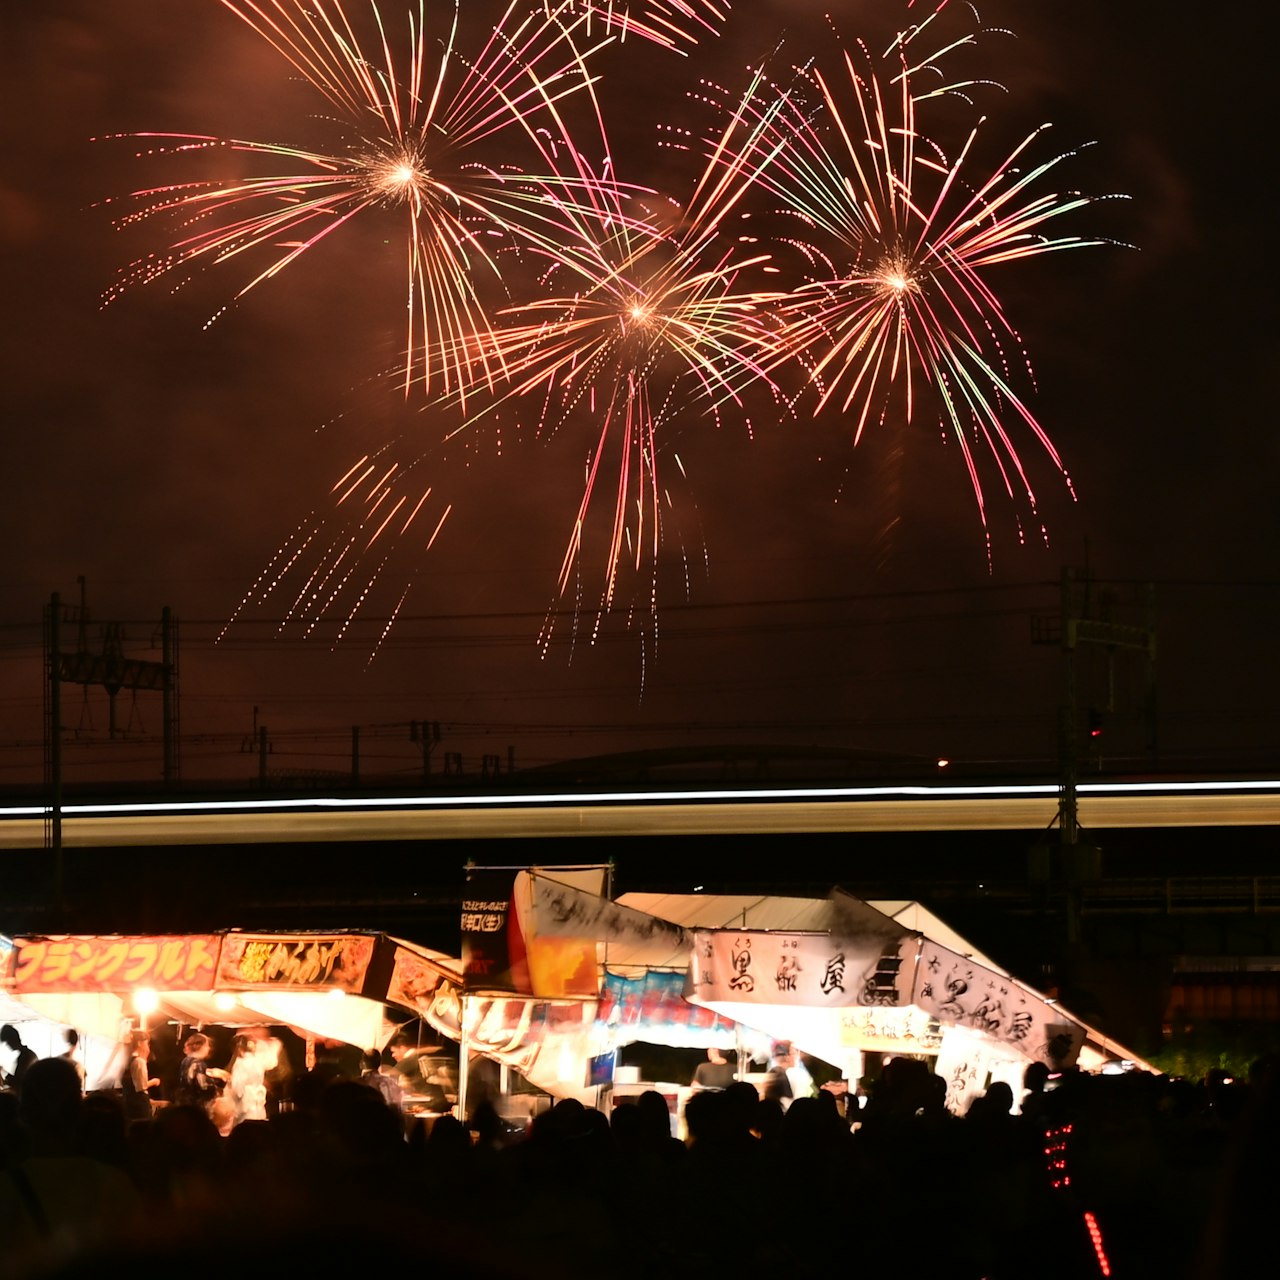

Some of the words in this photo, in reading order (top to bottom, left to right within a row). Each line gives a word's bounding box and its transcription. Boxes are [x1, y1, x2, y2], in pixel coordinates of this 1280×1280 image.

[13, 938, 216, 984] フランクフルト
